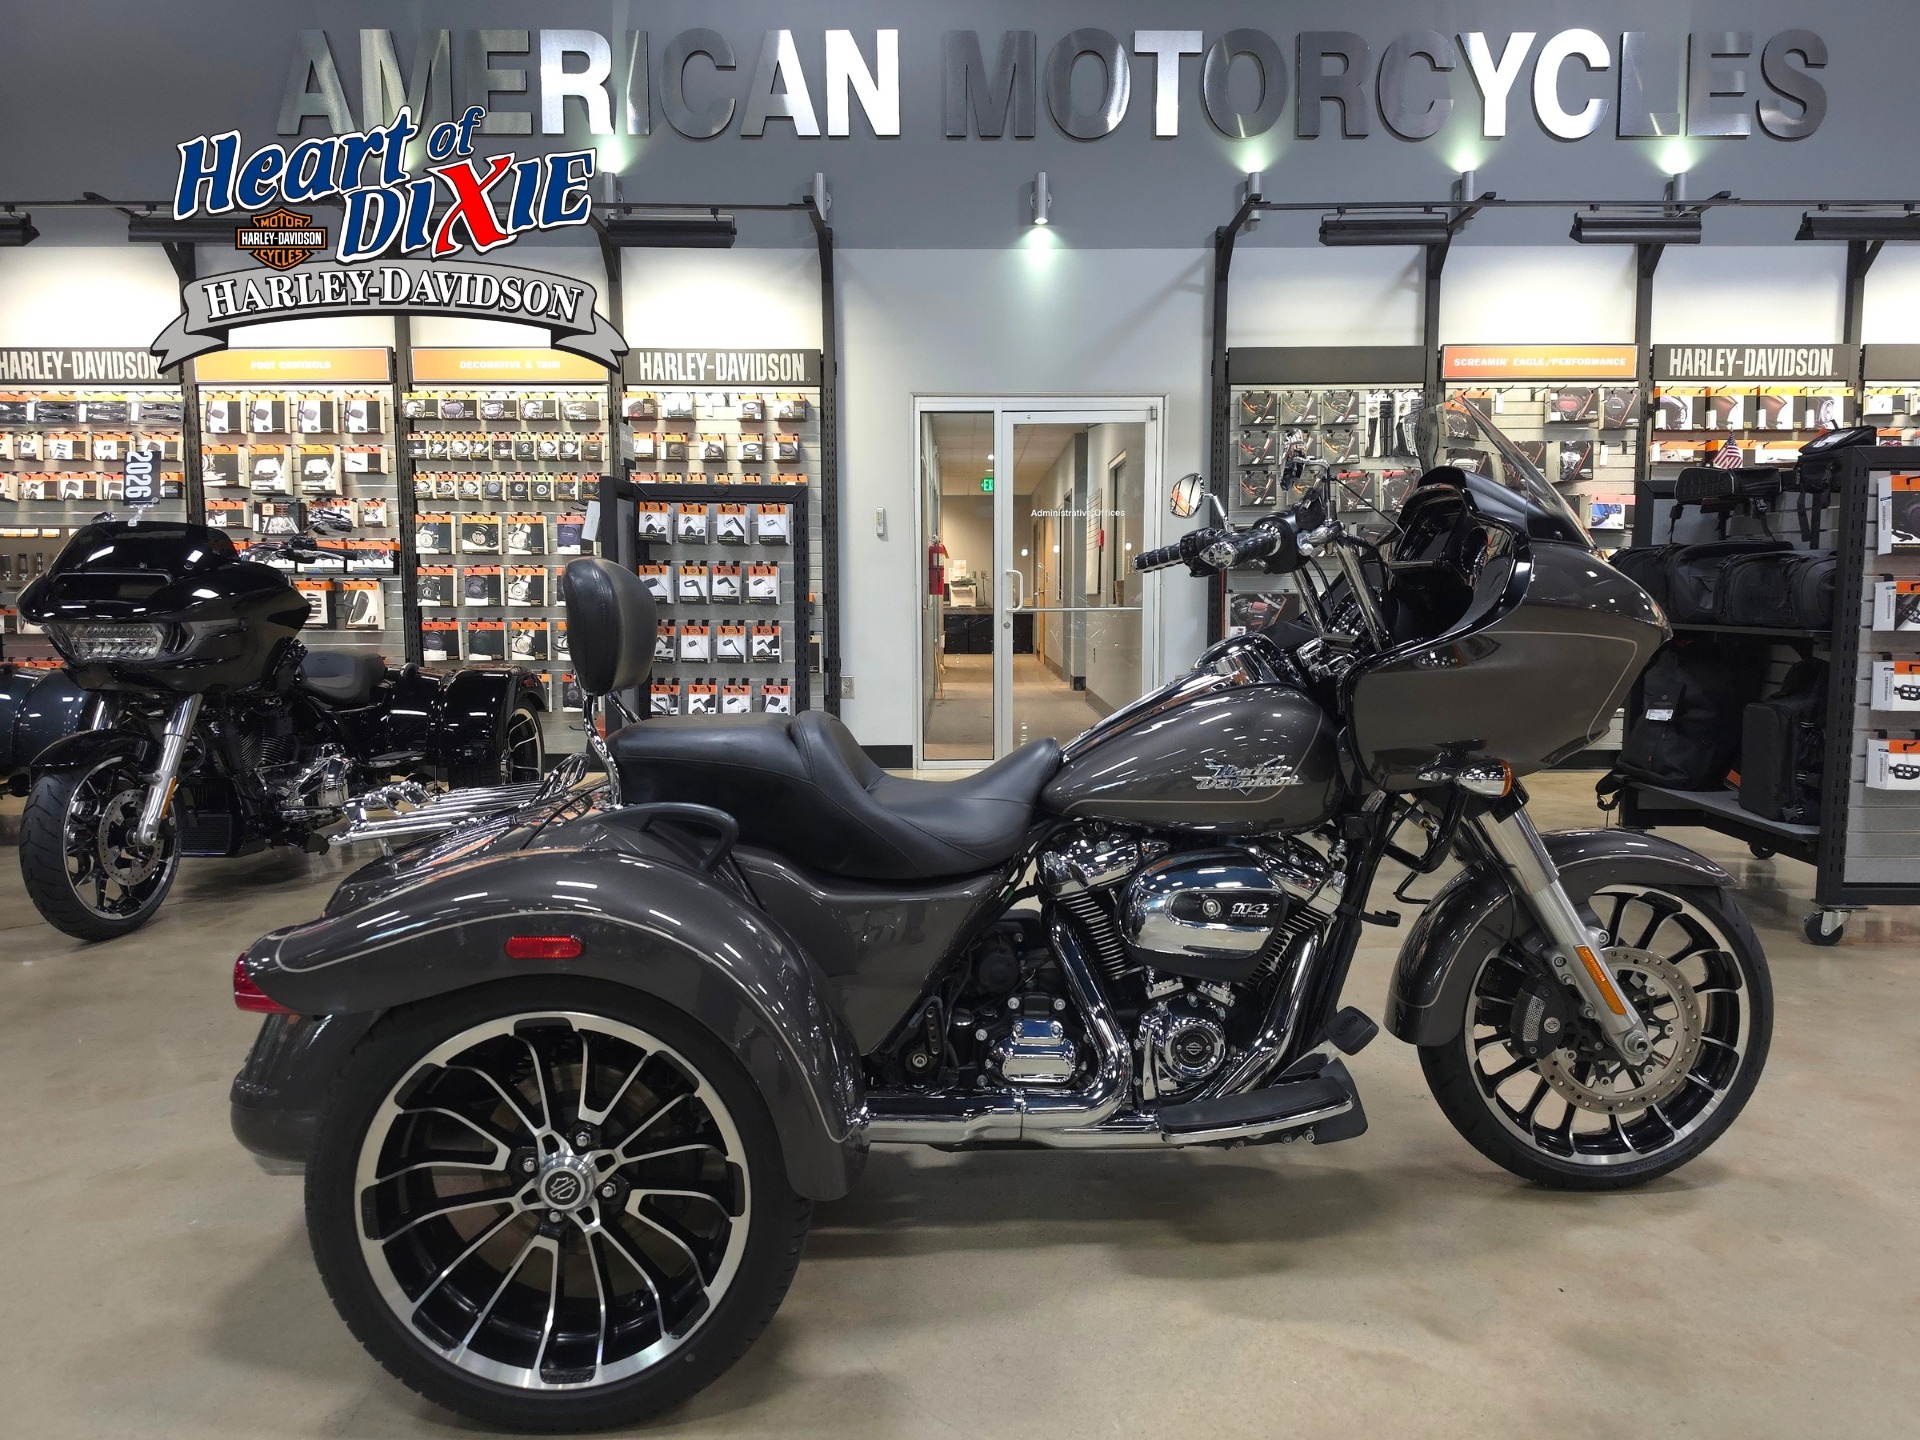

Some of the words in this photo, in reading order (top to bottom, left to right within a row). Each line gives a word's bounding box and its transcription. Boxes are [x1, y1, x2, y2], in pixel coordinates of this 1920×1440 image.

[277, 29, 900, 138] AMERICAN
[944, 29, 1829, 140] MOTORCYCLES
[250, 361, 275, 369] FOOT
[279, 361, 332, 369] CONTROLS
[460, 360, 522, 369] DECORATIVE
[525, 360, 533, 369] &
[639, 351, 805, 382] HARLEY-DAVIDSON
[1454, 357, 1510, 367] SCREAMIN'
[1669, 348, 1834, 377] HARLEY-DAVIDSON
[125, 450, 153, 499] 2026
[1030, 508, 1092, 518] Administrative
[1231, 902, 1270, 915] 114
